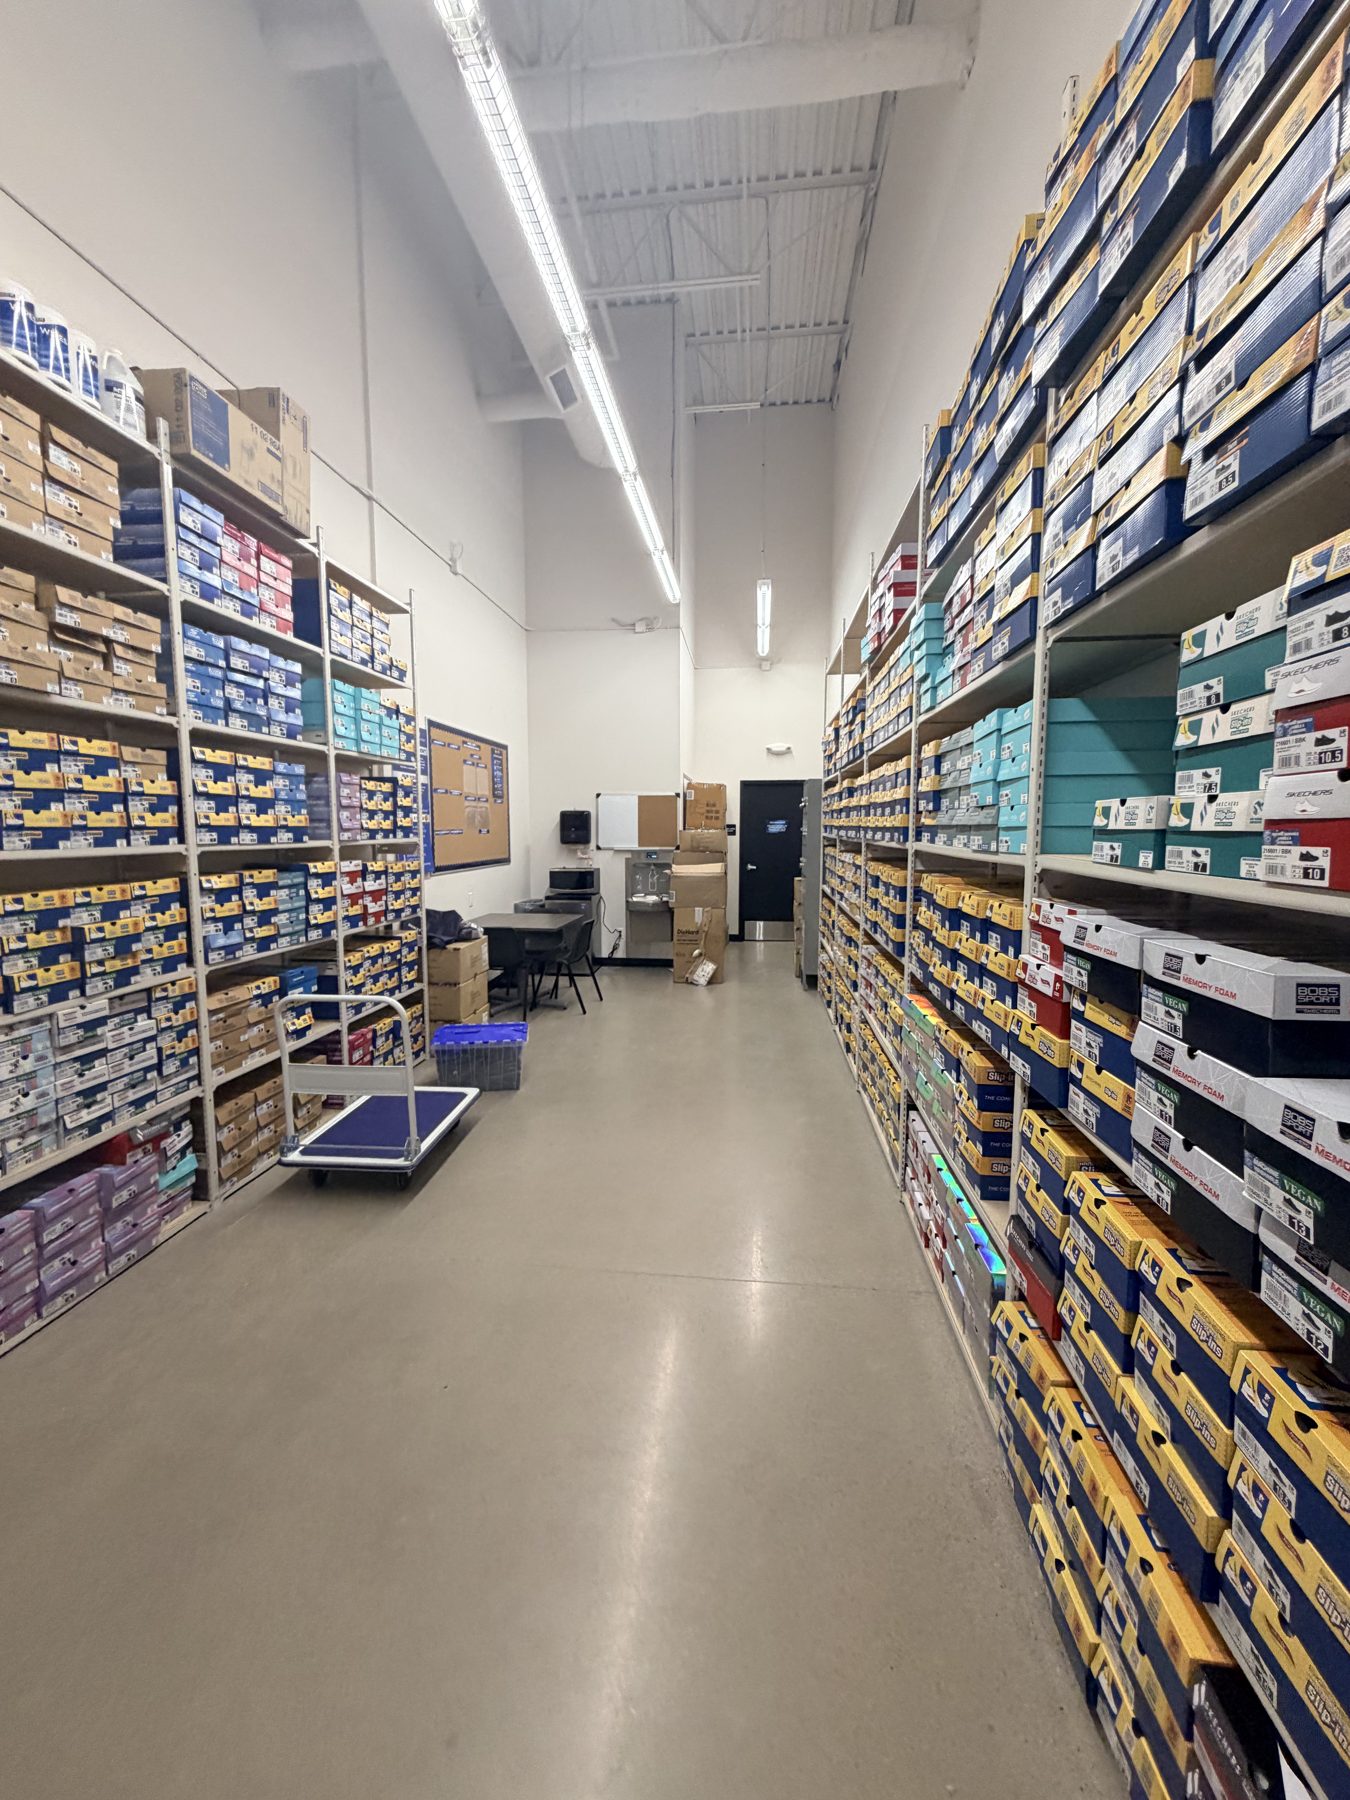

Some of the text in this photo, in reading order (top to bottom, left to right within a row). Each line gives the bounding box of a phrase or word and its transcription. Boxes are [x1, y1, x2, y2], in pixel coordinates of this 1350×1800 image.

[1221, 473, 1233, 489] 8.5
[1341, 626, 1349, 638] 8
[1280, 655, 1342, 680] SKECHERS
[1320, 750, 1342, 763] 10.5
[1204, 783, 1217, 793] 7.5
[1285, 788, 1334, 798] SKECHERS
[1307, 868, 1320, 880] 10
[1182, 975, 1213, 992] MEMORY
[1214, 986, 1237, 1001] FOAM
[1298, 986, 1339, 996] BOBS
[1165, 996, 1187, 1013] VEGAN
[1297, 995, 1339, 1003] SPORT
[1157, 1082, 1180, 1103] VEGAN
[1172, 1067, 1225, 1102] MEMORY FOAM
[1154, 1165, 1177, 1192] VEGAN
[1169, 1156, 1198, 1182] MEMORY
[1199, 1180, 1220, 1201] FOAM
[1283, 1179, 1322, 1212] VEGAN
[1291, 1217, 1306, 1236] 13
[1302, 1291, 1342, 1334] VEGAN
[1190, 1315, 1223, 1360] Slip-ins
[1309, 1333, 1325, 1354] 12
[1184, 1400, 1217, 1450] Slip-ins
[1167, 1474, 1197, 1526] Slip-ins
